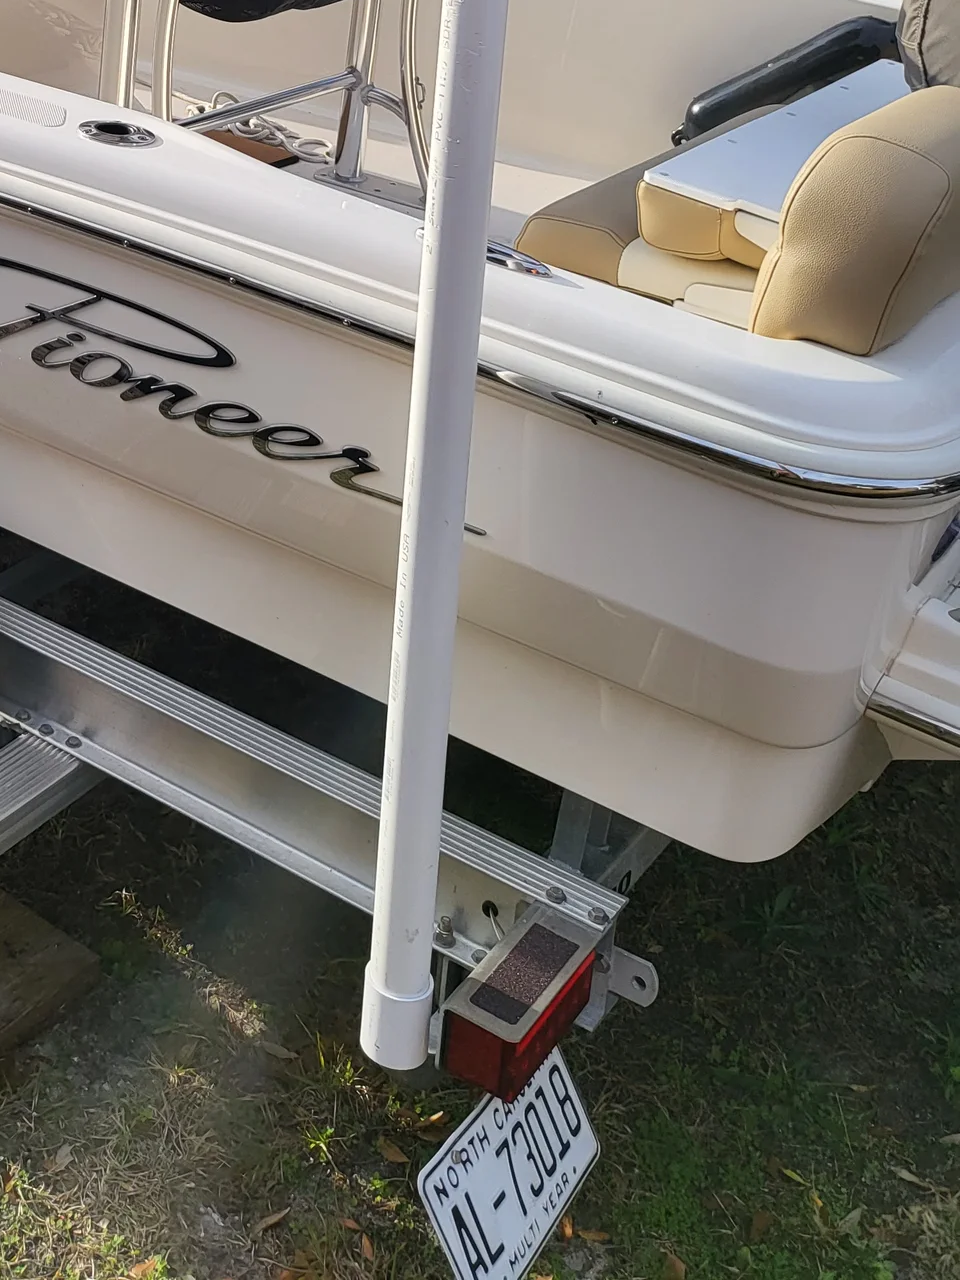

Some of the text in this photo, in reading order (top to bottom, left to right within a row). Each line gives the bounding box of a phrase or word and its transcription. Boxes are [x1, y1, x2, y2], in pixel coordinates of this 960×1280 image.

[395, 531, 410, 639] Made In USA
[433, 1125, 491, 1207] NORTH
[451, 1063, 581, 1280] AL-73018
[508, 1171, 570, 1274] MULTI YEAR
